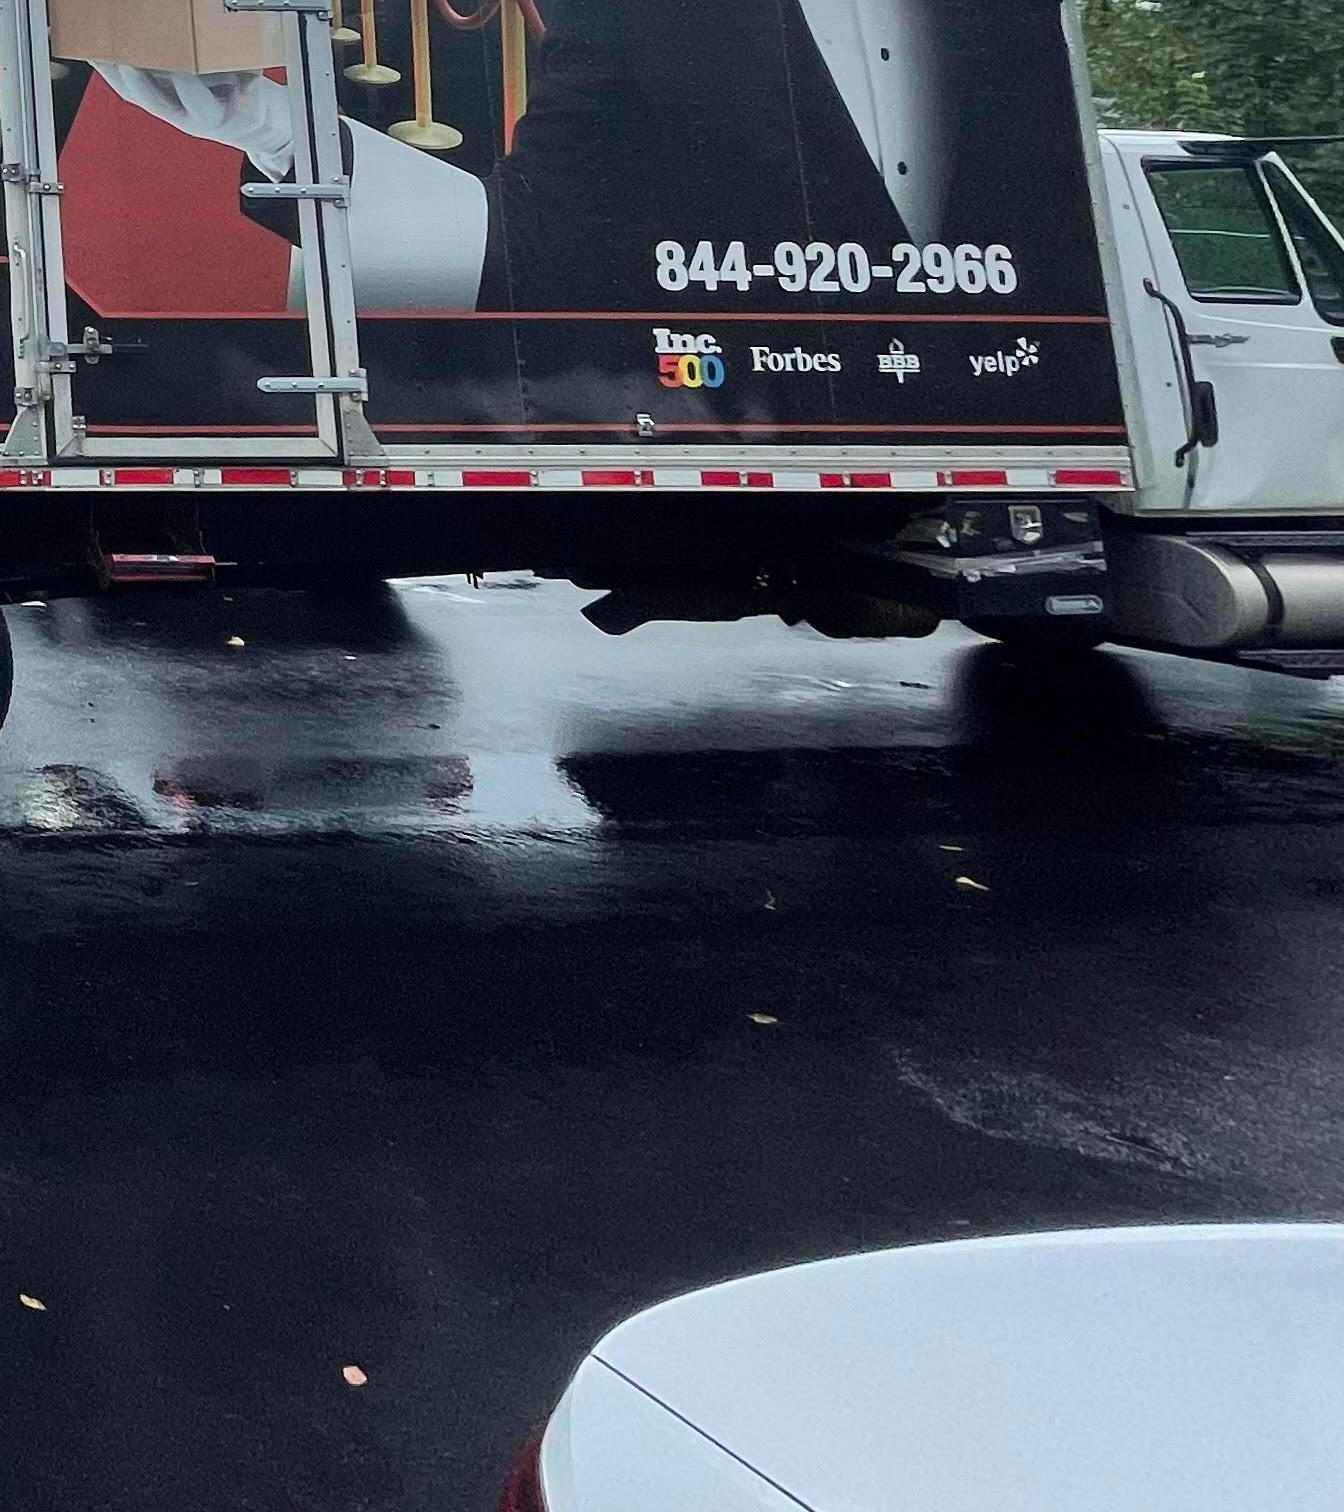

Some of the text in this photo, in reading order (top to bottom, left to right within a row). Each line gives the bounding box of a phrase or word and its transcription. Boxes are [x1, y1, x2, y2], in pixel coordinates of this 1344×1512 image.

[655, 240, 1018, 295] 844-920-2966
[653, 328, 723, 355] Inc.
[658, 354, 725, 388] 500
[750, 345, 842, 373] Forbes
[877, 354, 921, 369] BBB
[969, 350, 1020, 377] yelp
